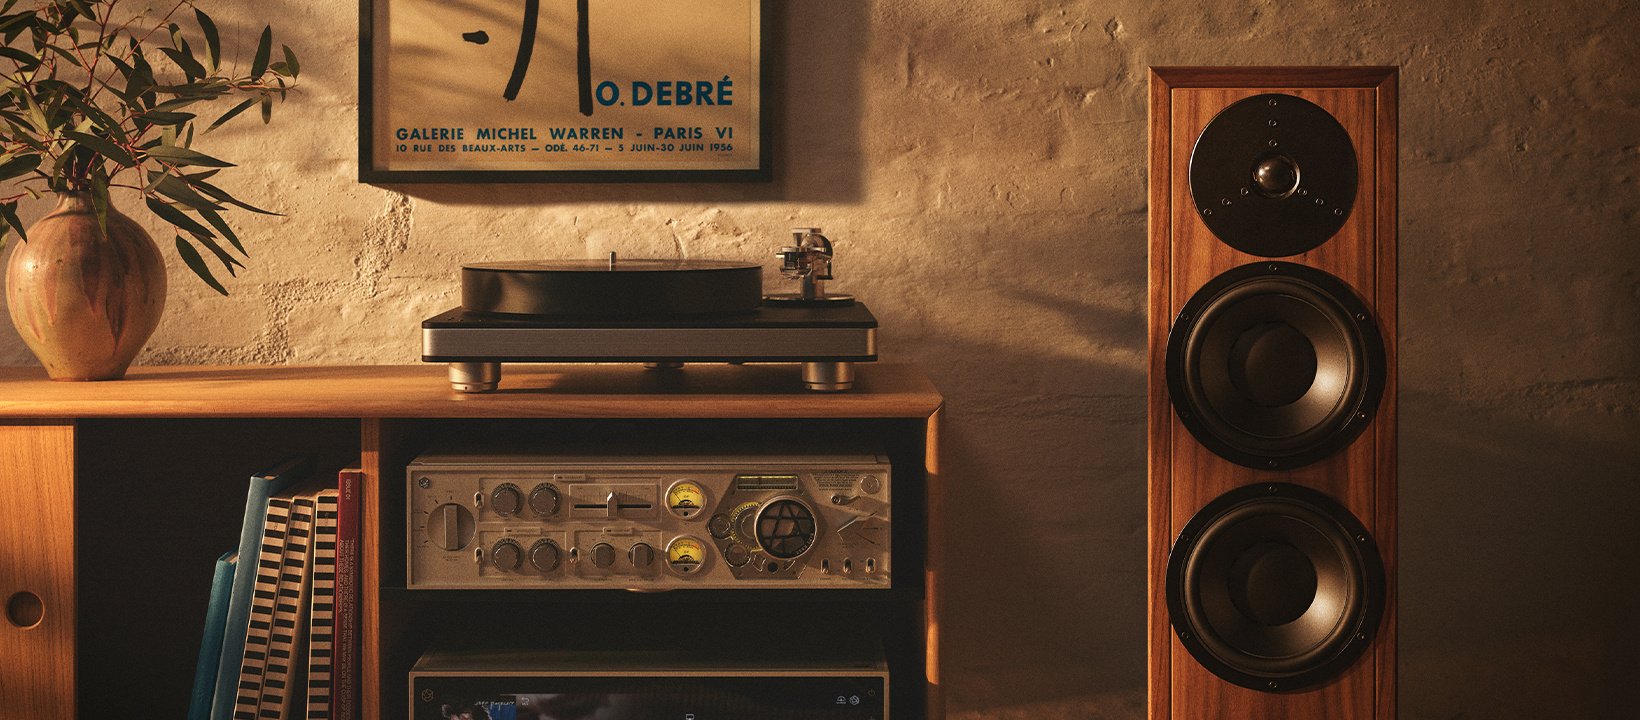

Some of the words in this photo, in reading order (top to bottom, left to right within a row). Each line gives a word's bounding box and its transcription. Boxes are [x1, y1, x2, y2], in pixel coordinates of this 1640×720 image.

[595, 81, 625, 106] O.
[632, 75, 733, 106] DEBRÉ
[396, 127, 464, 140] GALERIE
[476, 127, 537, 140] MICHEL
[549, 127, 624, 140] WARREN
[653, 127, 703, 140] PARIS
[715, 127, 733, 139] VI
[413, 144, 432, 153] RUE
[438, 144, 456, 153] DES
[462, 144, 526, 153] BEAUX-ARTS
[572, 144, 599, 153] 46-71
[618, 144, 624, 153] 5
[630, 144, 675, 153] JUIN-30
[679, 144, 705, 153] JUIN
[709, 144, 734, 153] 1956
